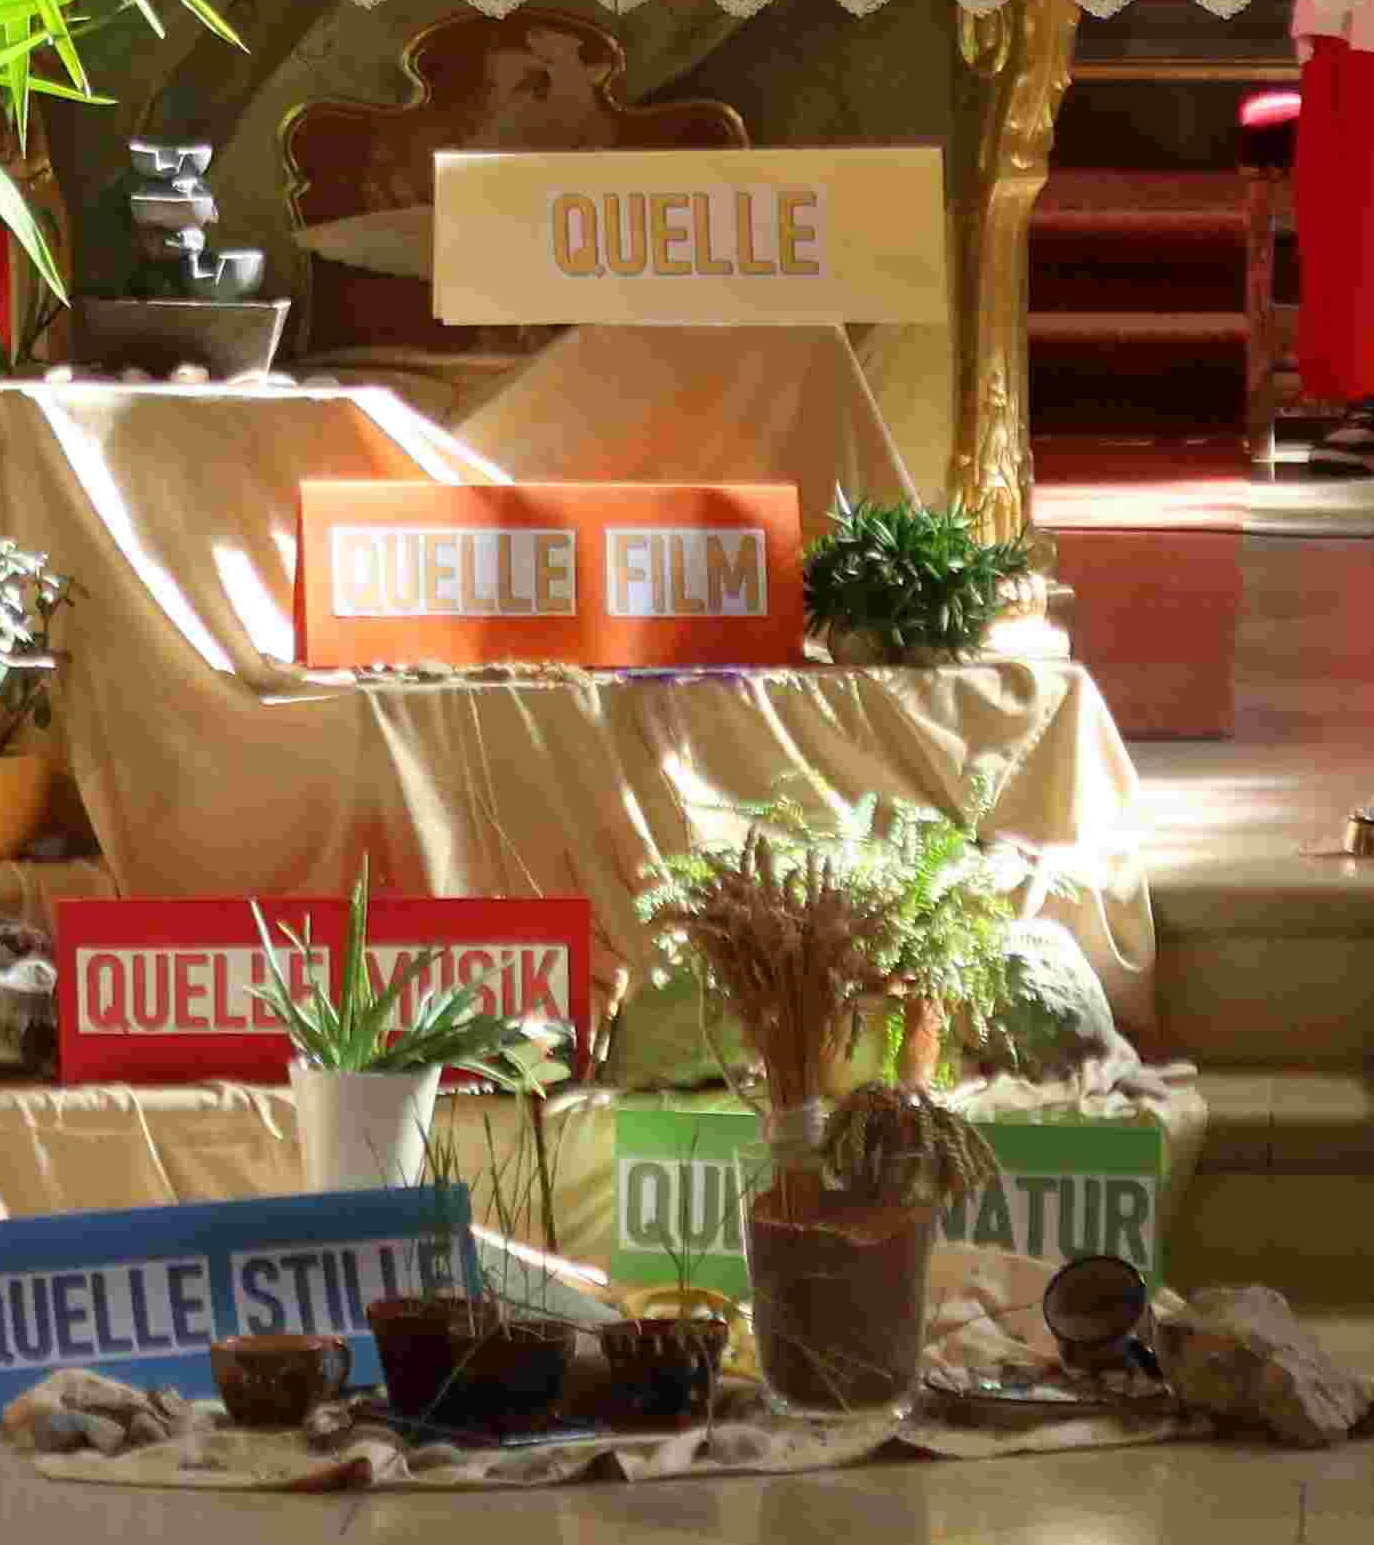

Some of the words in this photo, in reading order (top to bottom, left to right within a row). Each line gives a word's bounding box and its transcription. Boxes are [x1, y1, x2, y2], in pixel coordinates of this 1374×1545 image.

[552, 191, 820, 279] QUELLE
[337, 533, 574, 614] QUELLE
[610, 533, 764, 615] FILM
[85, 953, 324, 1032] QUELLE
